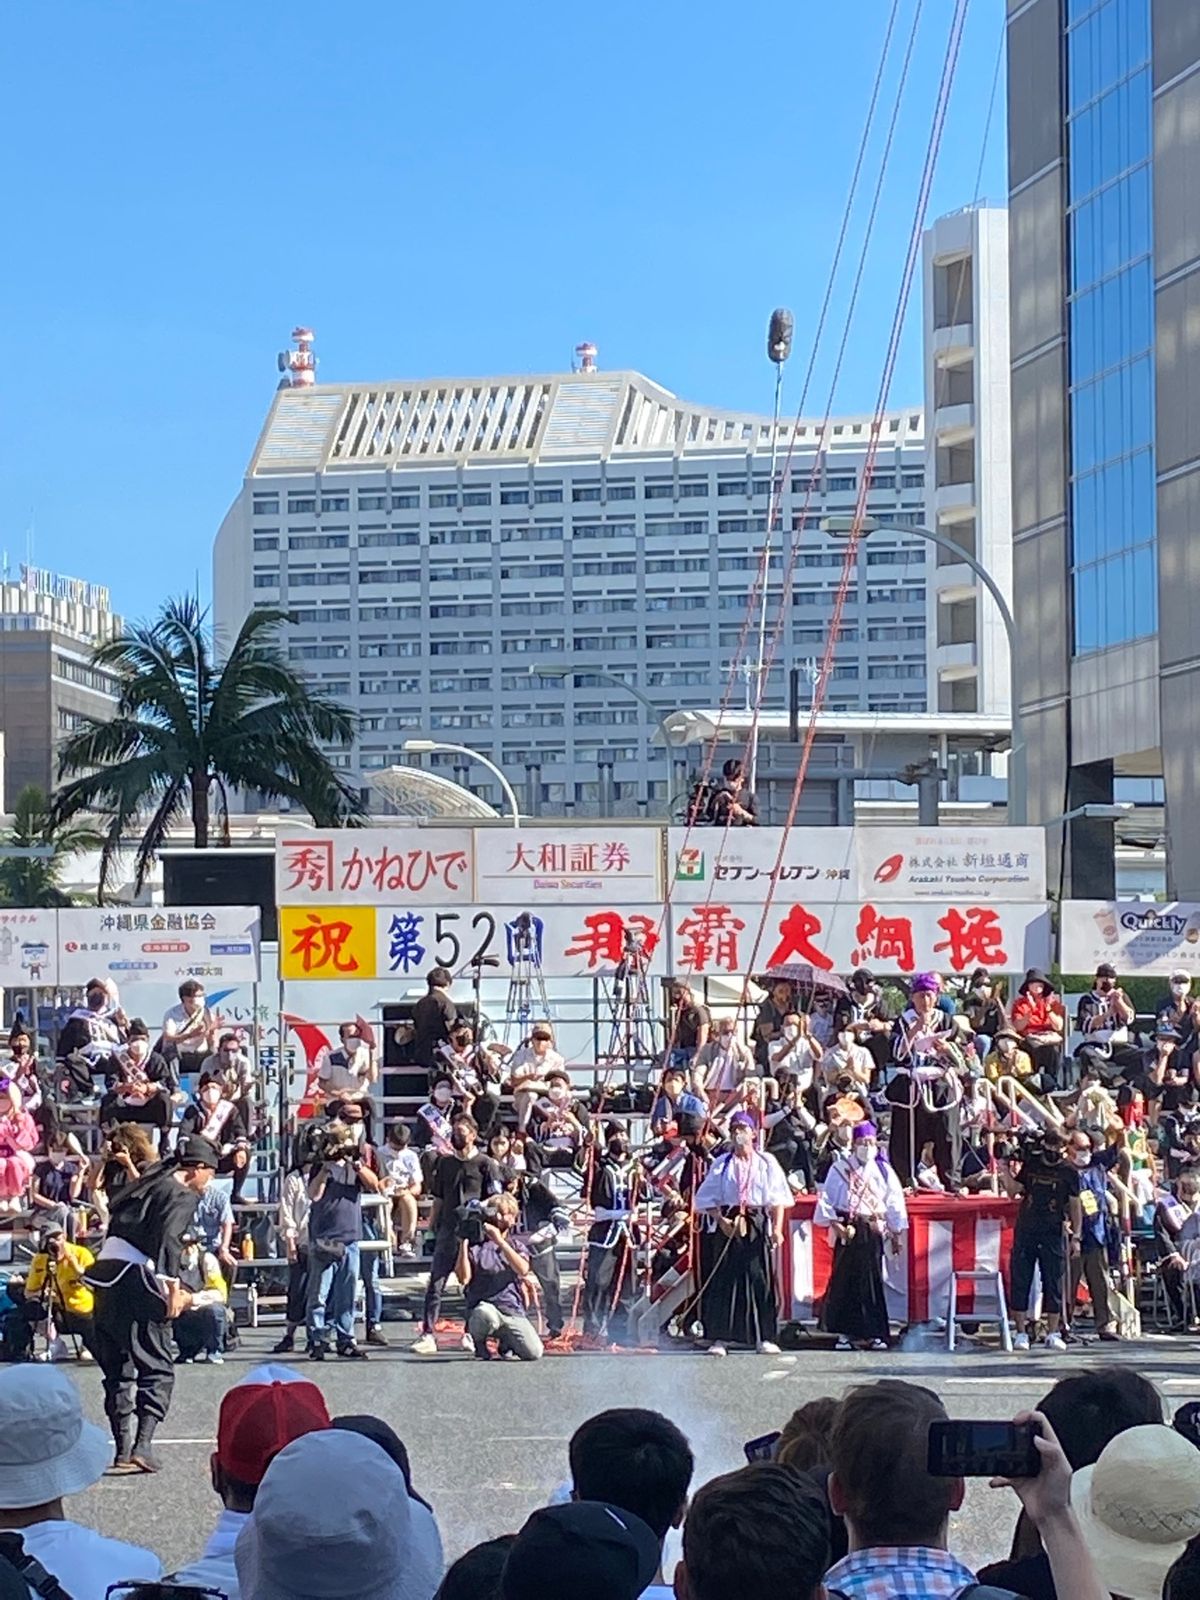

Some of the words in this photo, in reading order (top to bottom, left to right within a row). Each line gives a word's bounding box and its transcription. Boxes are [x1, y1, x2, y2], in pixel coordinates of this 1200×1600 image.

[341, 846, 467, 892] かねひで
[506, 842, 630, 873] 大和証券
[909, 856, 958, 869] 株式会社
[978, 875, 1030, 884] Corporation
[100, 913, 217, 931] 沖縄県金融協会
[1120, 911, 1187, 935] Quickly
[291, 913, 359, 973] 祝
